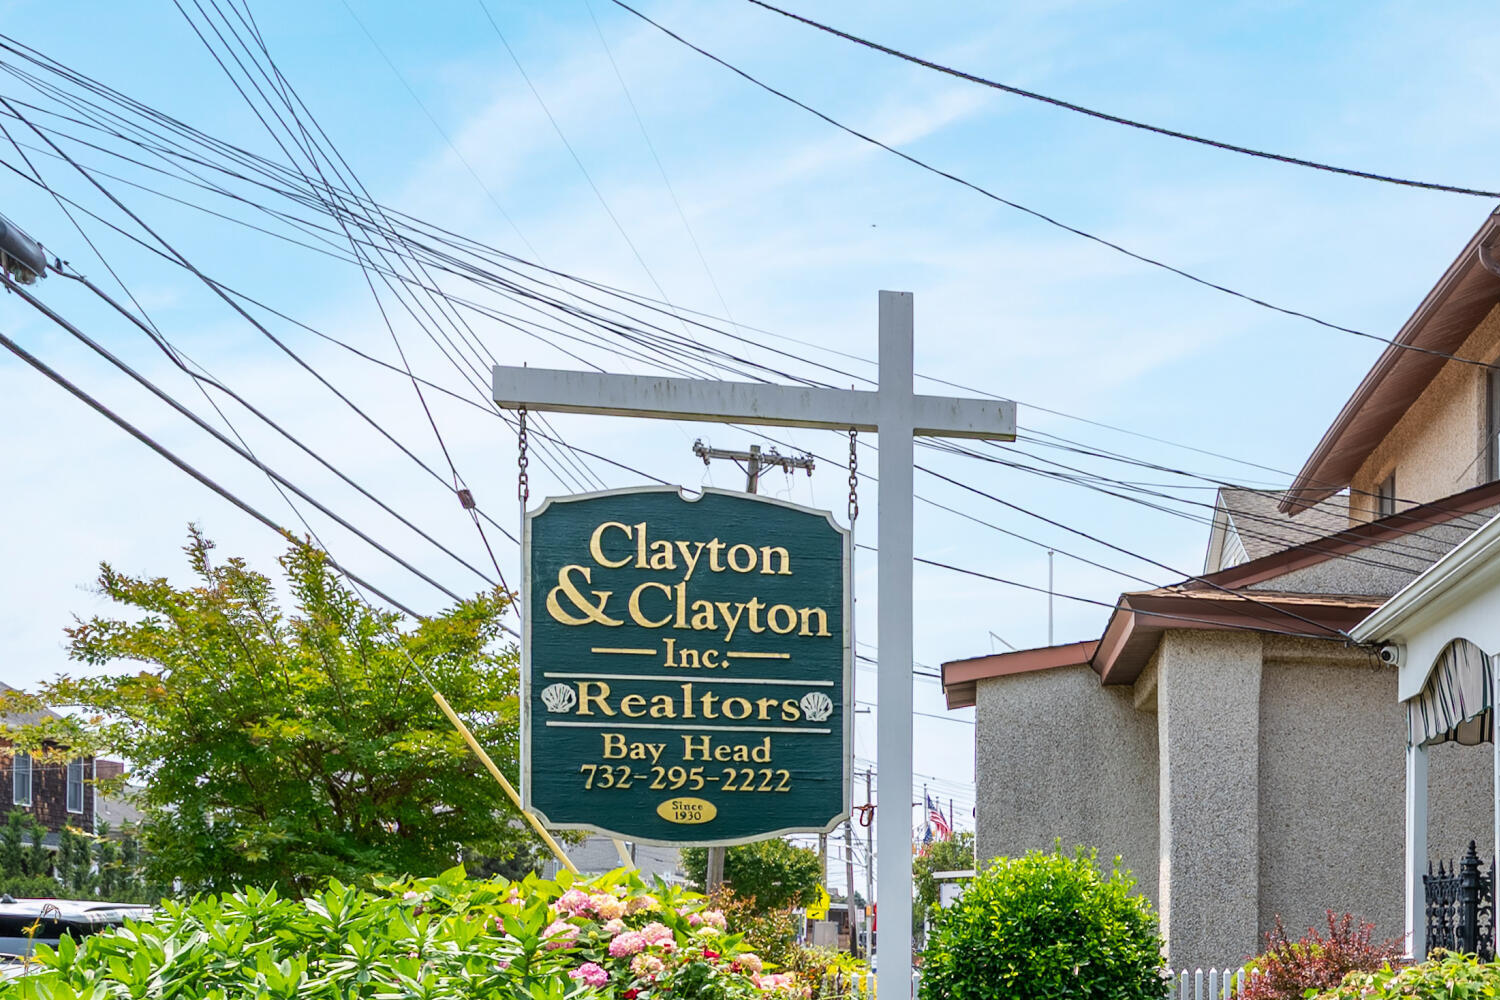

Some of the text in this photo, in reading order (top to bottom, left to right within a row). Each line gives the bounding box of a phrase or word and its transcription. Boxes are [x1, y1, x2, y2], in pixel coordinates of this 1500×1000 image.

[589, 521, 793, 580] Clayton
[545, 564, 832, 642] & Clayton
[663, 638, 729, 669] Inc.
[575, 681, 801, 721] Realtors
[600, 733, 772, 765] Bay Head
[579, 764, 792, 793] 732-295-2222
[672, 801, 703, 810] Since
[675, 811, 702, 820] 1930
